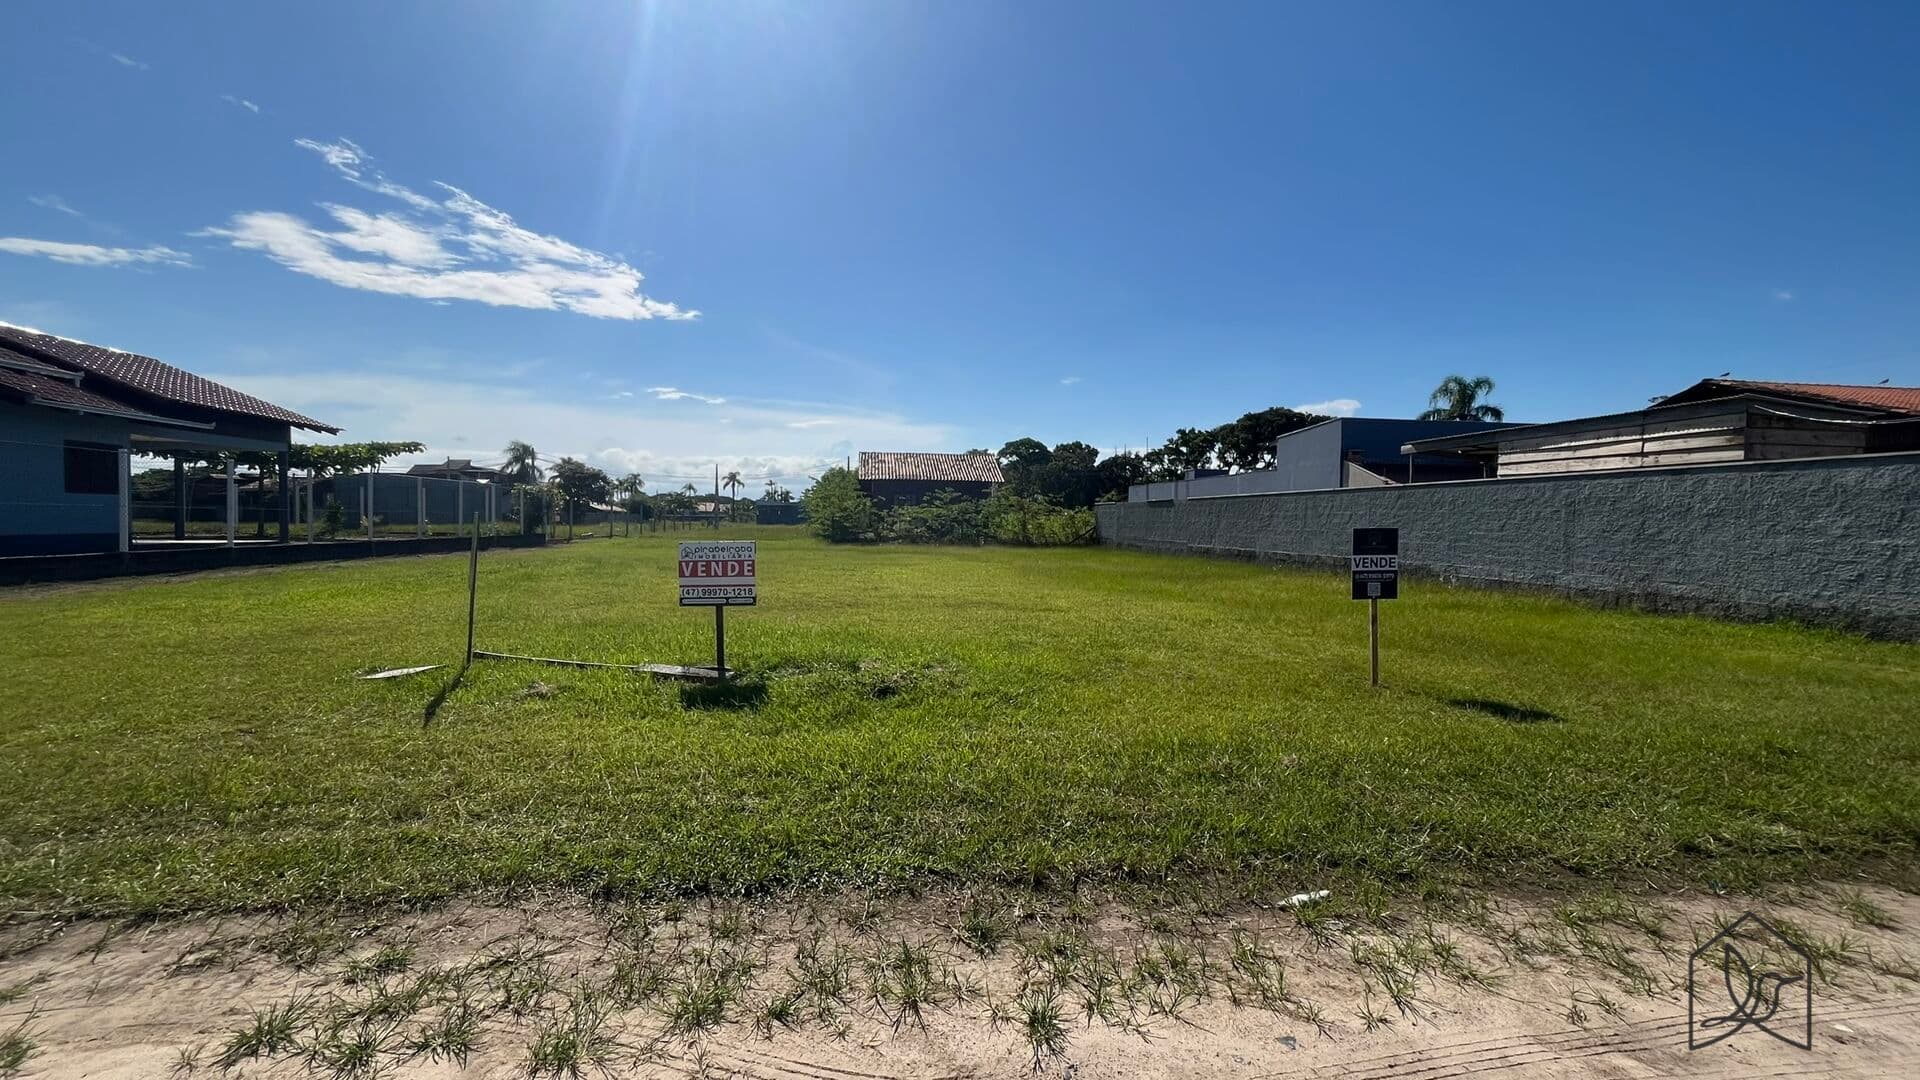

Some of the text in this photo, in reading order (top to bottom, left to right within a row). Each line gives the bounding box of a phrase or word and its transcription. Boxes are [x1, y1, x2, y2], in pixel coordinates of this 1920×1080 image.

[681, 561, 753, 576] VENDE
[1353, 557, 1396, 569] VENDE
[682, 588, 753, 596] (47) 99970-1218
